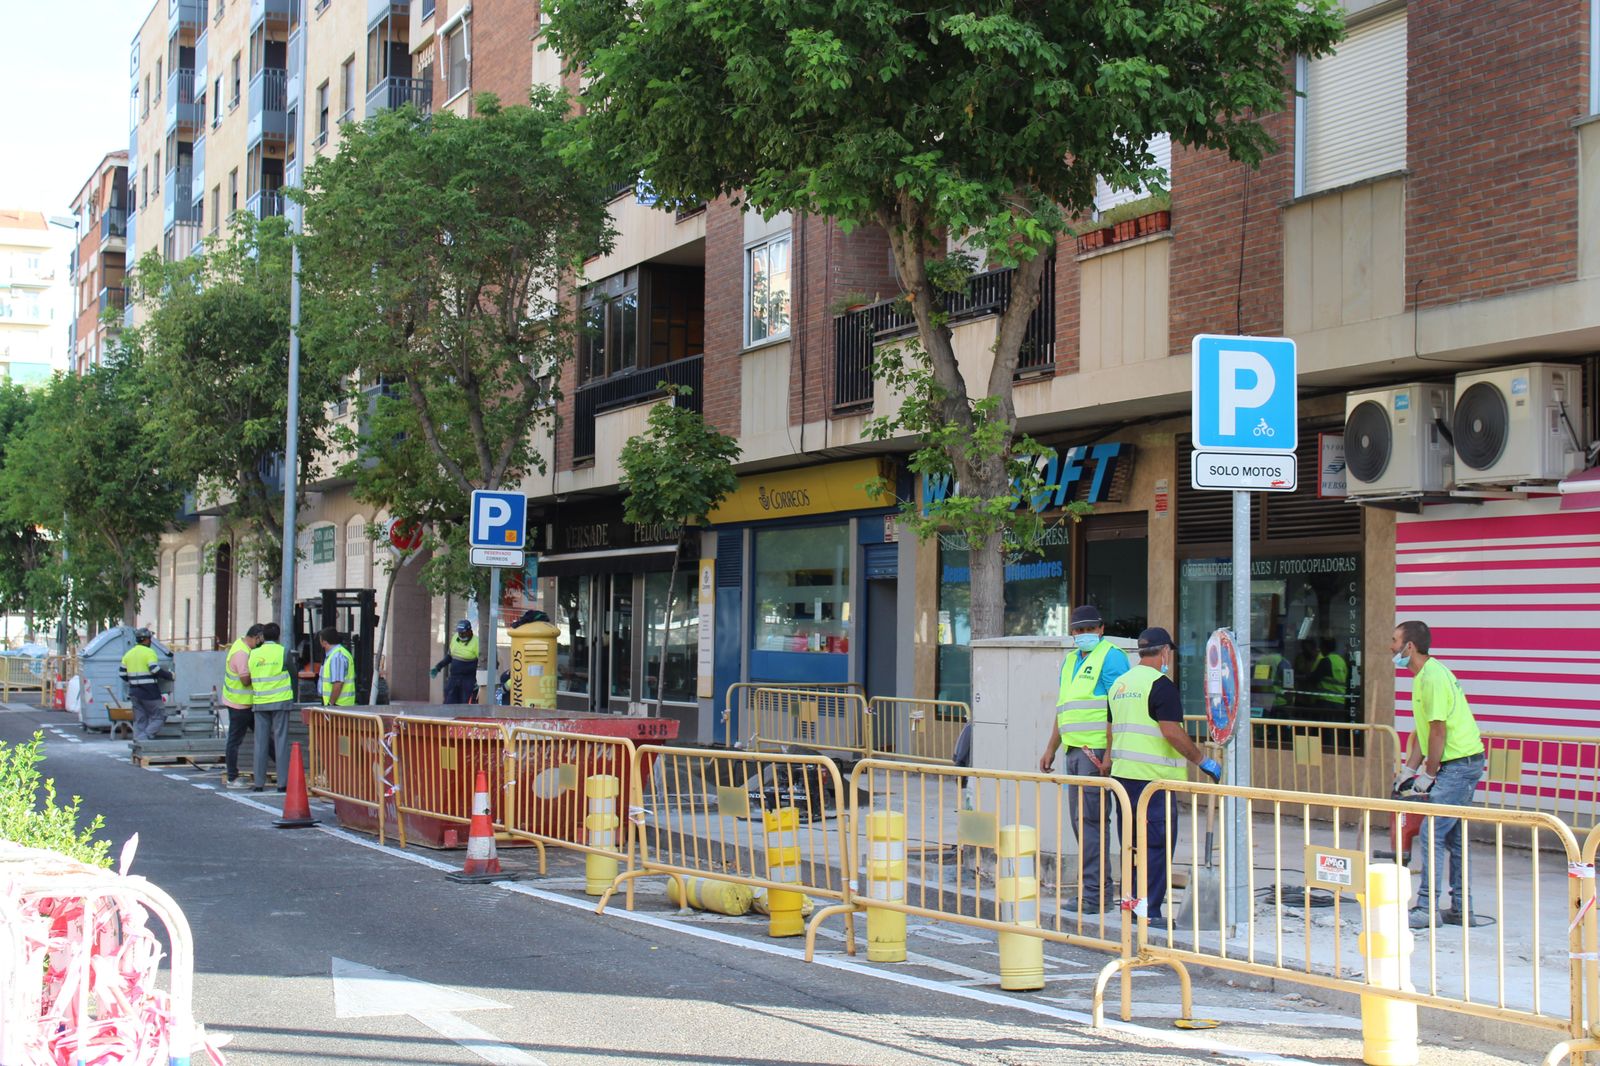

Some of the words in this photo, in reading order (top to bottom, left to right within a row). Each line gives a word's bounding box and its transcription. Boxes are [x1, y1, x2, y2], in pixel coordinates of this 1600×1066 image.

[1218, 350, 1276, 436] P
[1209, 465, 1239, 476] SOLO
[1242, 467, 1282, 478] MOTOS
[478, 497, 512, 541] P
[566, 523, 608, 549] VERSADE
[1183, 562, 1233, 577] ORDENADORE
[1250, 561, 1271, 575] AXES
[1279, 556, 1356, 575] FOTOCOPIADORAS
